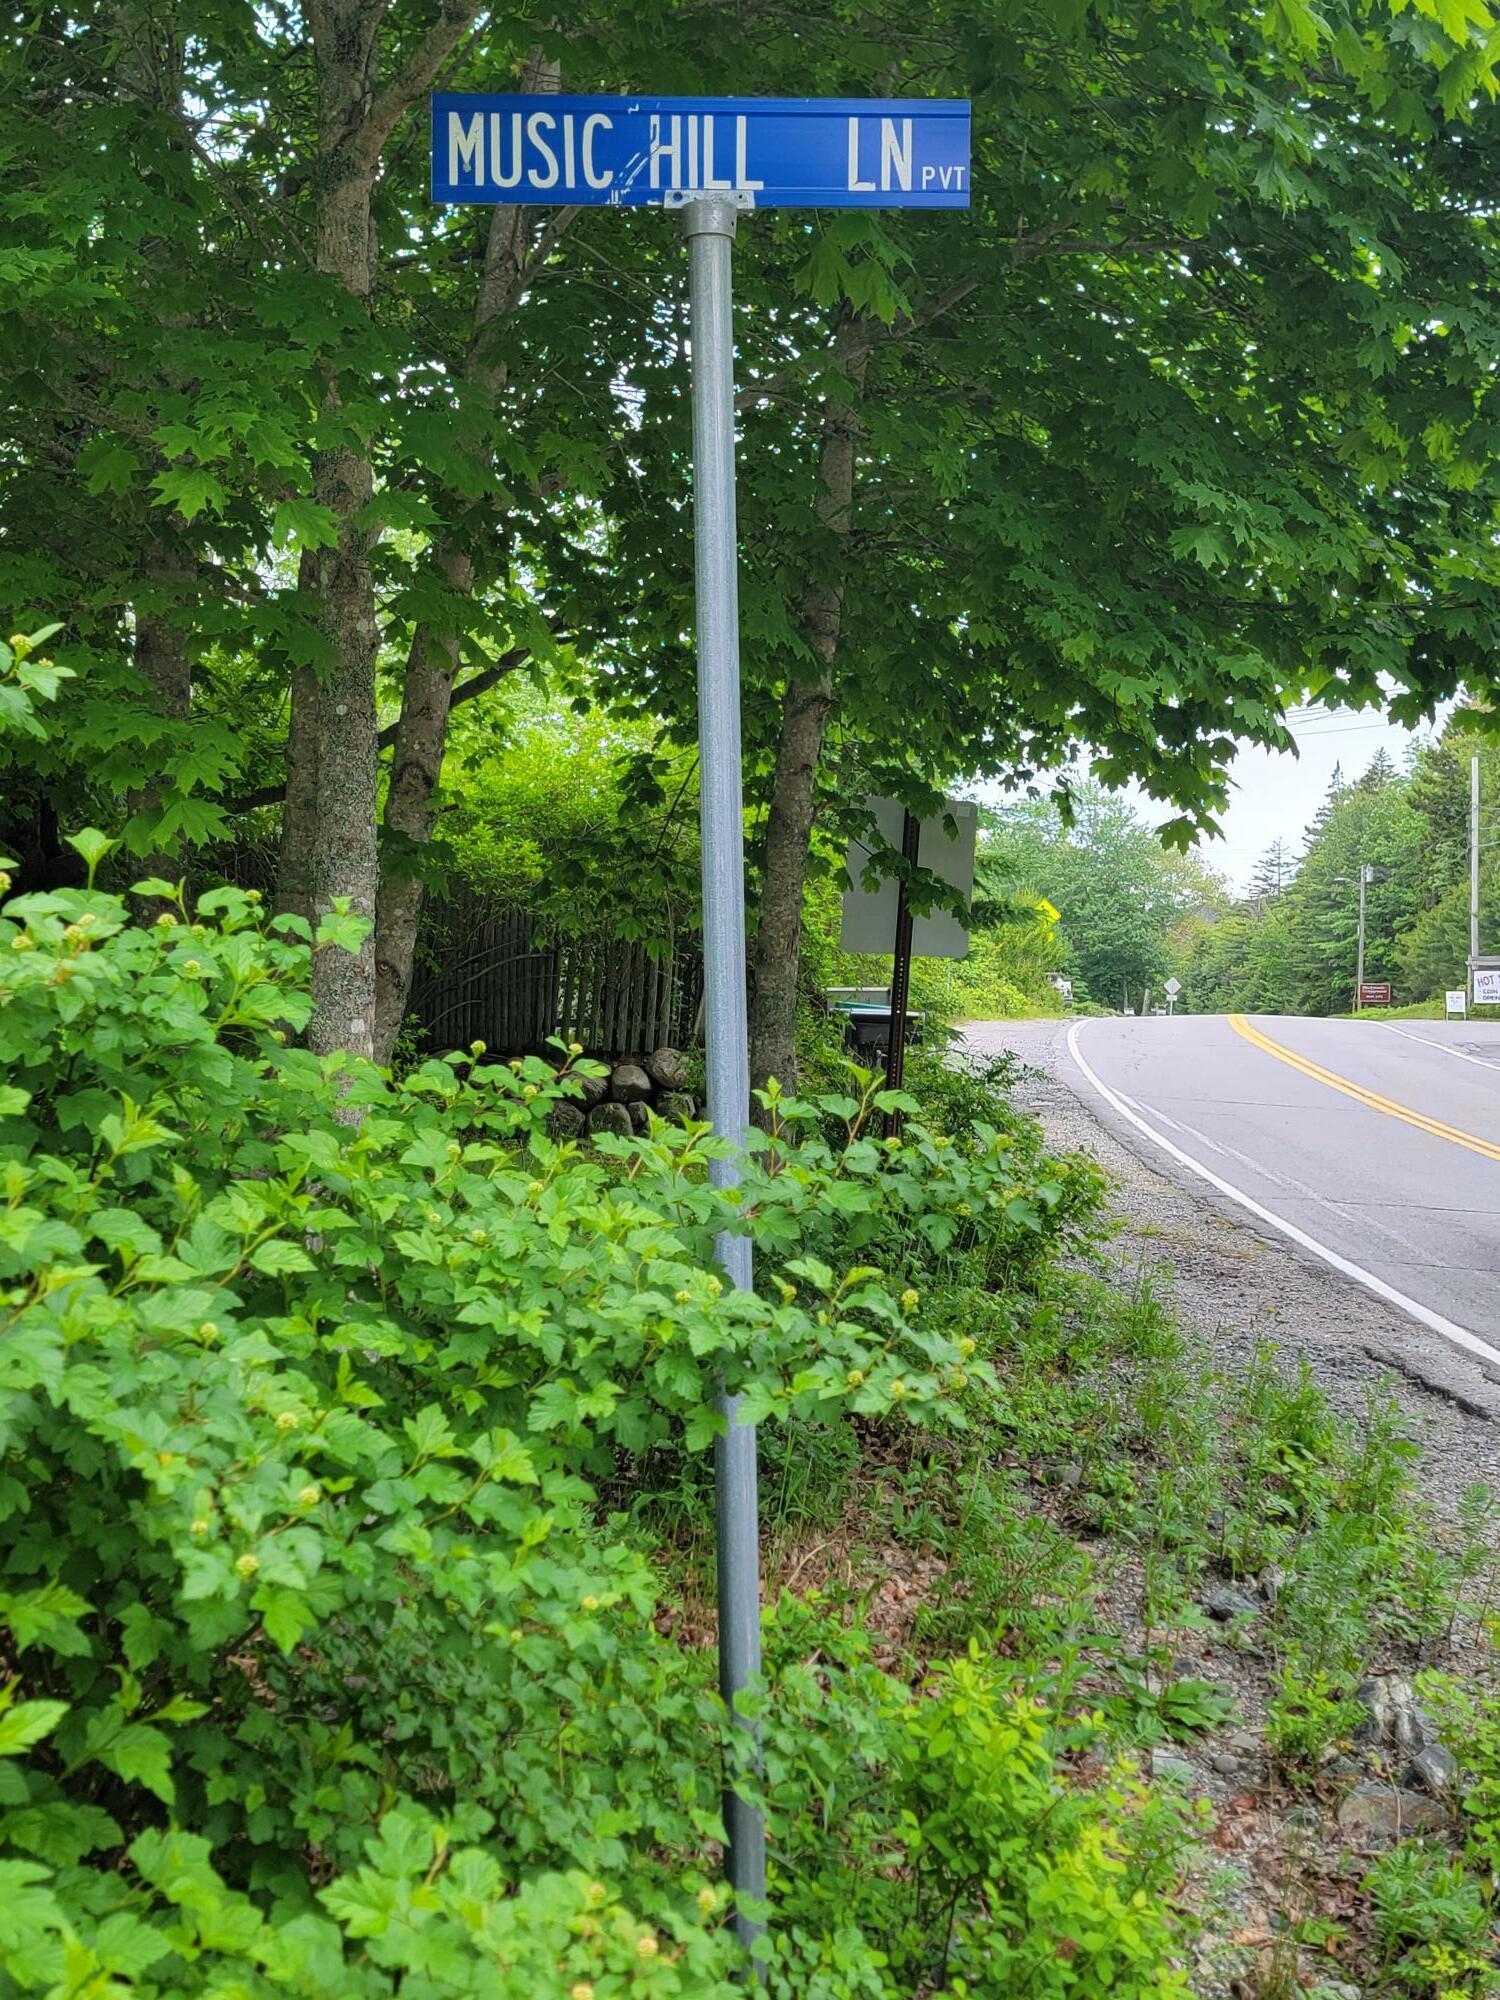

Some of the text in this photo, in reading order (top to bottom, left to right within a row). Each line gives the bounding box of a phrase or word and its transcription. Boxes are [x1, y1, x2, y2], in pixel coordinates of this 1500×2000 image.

[448, 111, 966, 191] MUSIC HILL LN PVT
[1477, 974, 1495, 987] HOT
